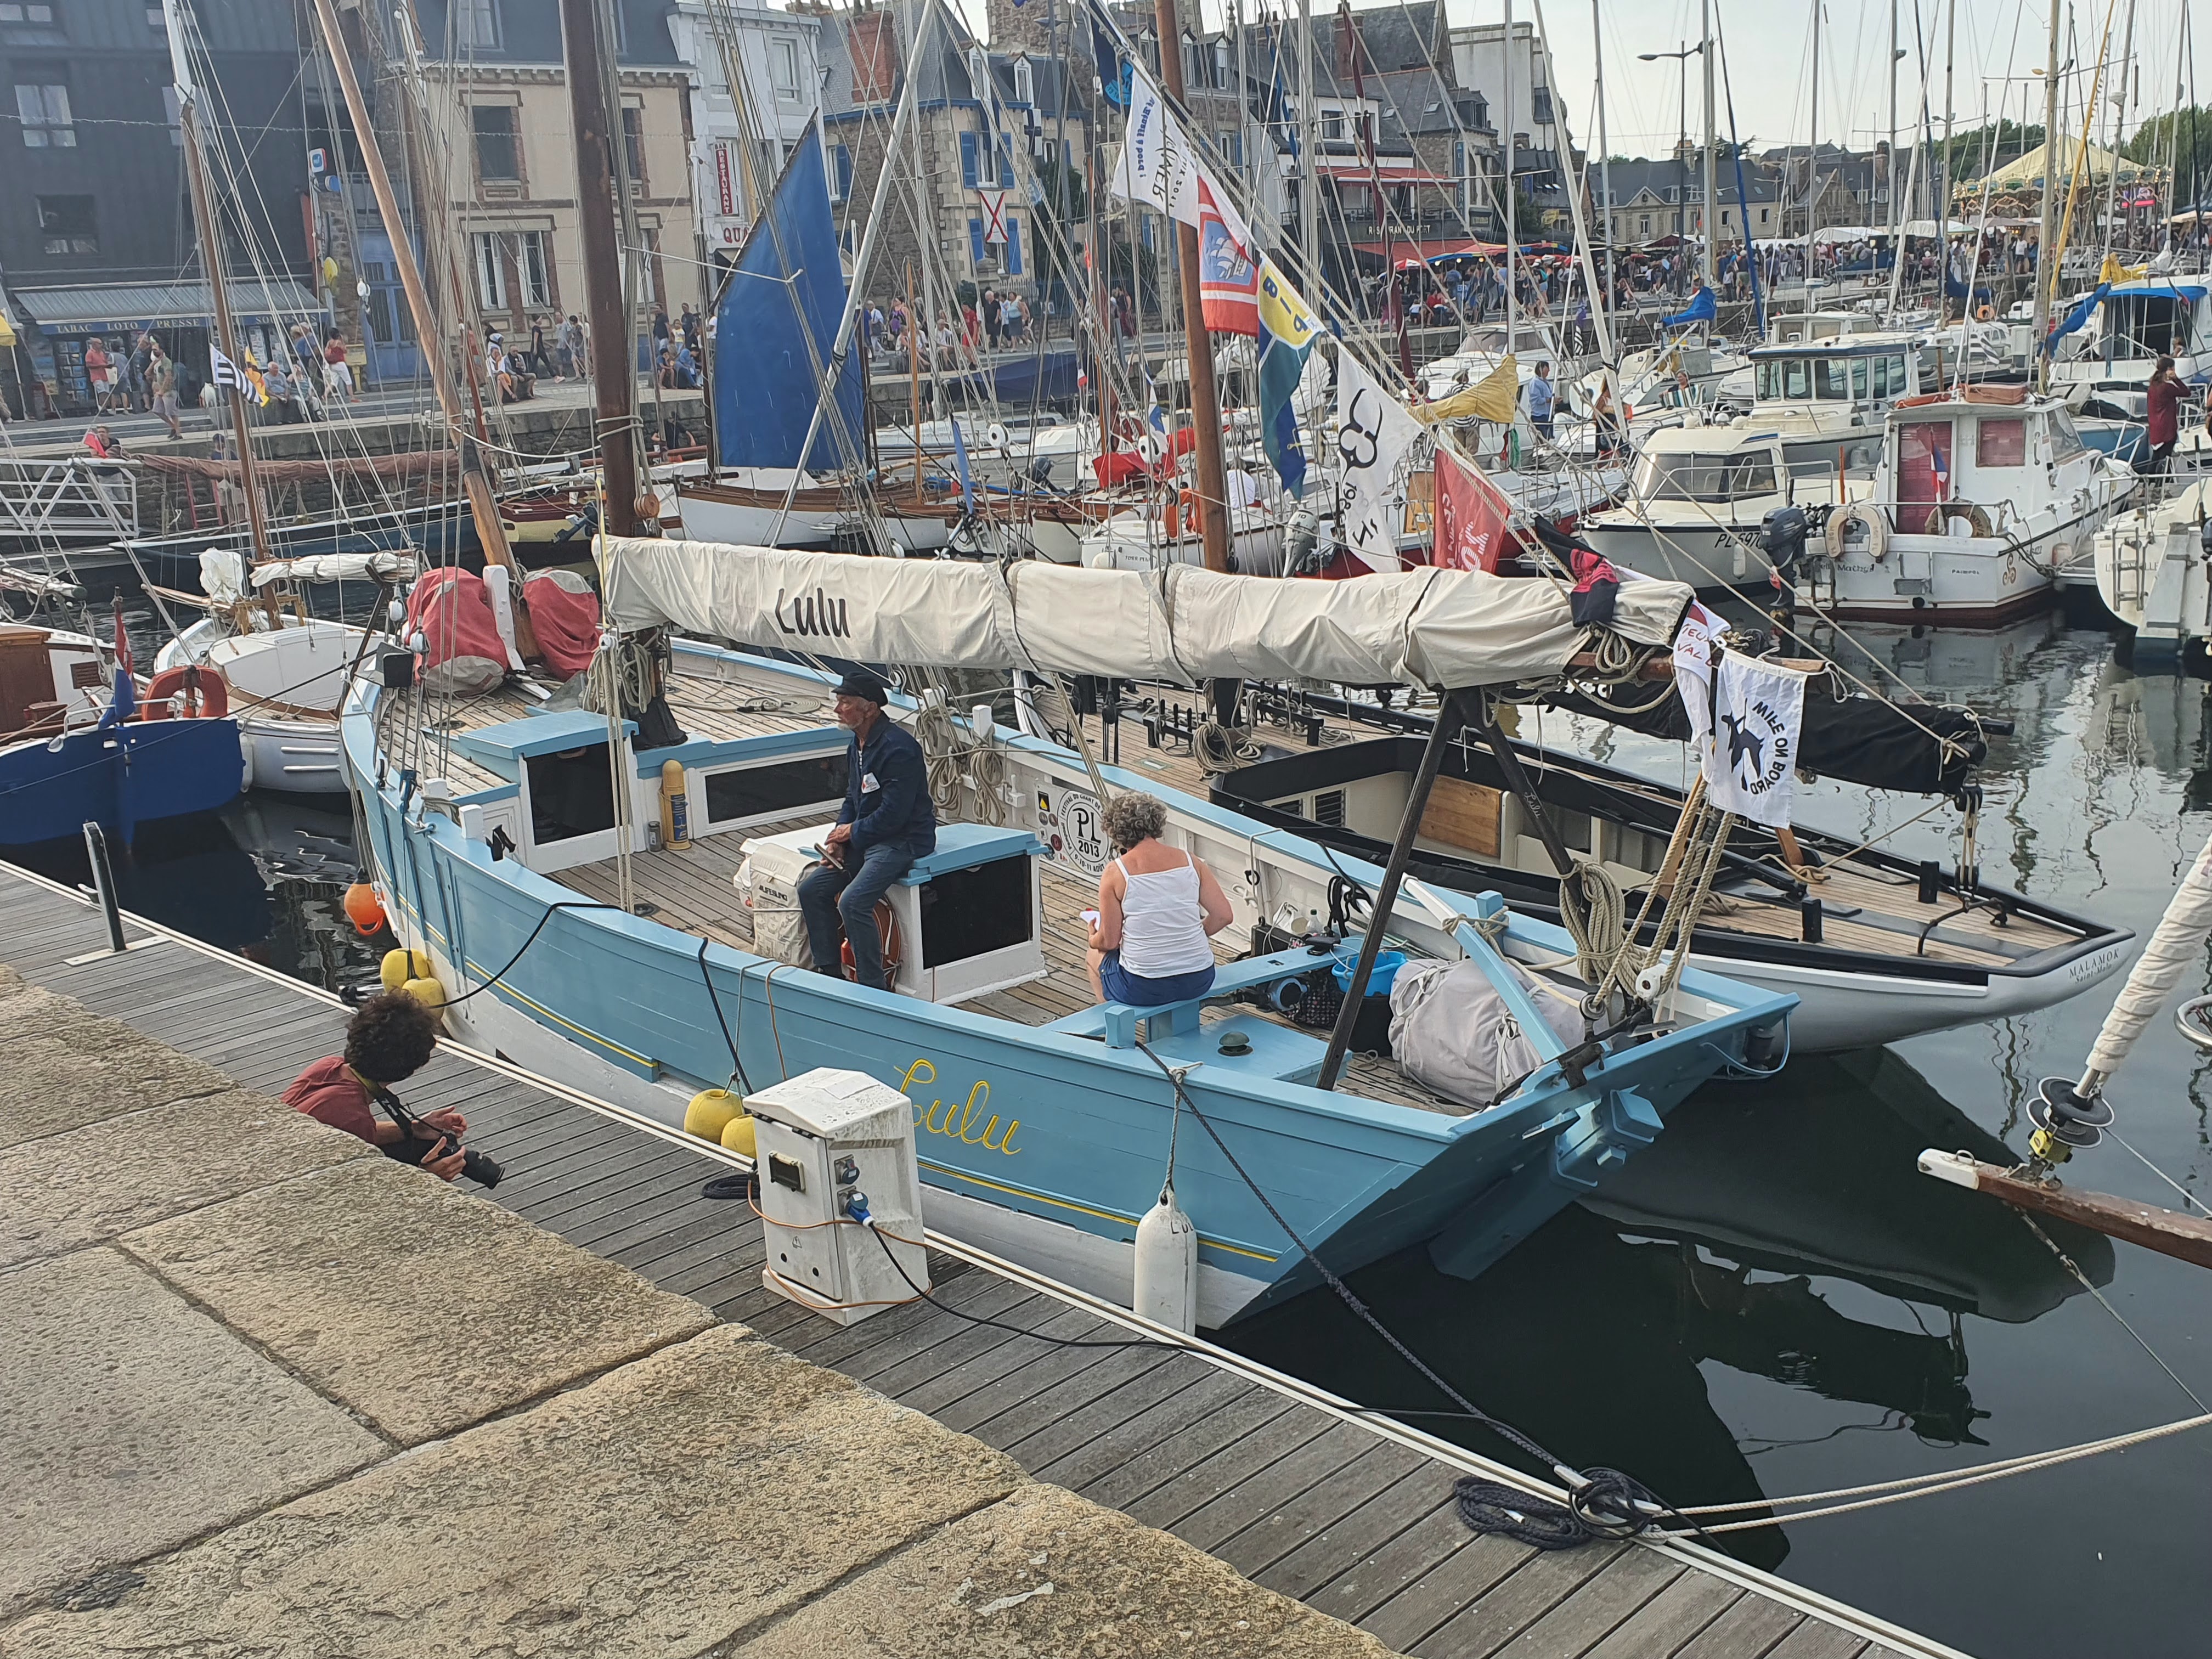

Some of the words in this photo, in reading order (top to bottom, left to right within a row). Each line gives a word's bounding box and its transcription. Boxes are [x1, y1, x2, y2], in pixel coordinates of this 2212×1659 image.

[718, 150, 730, 213] RESTAURANT
[1407, 225, 1414, 234] DU
[57, 324, 92, 333] TABAC
[106, 321, 138, 331] LOTO
[156, 318, 200, 328] PRESSE
[775, 587, 851, 638] Lulu
[1061, 794, 1074, 816] FESTIVAL
[1080, 794, 1094, 804] CHANT
[1073, 808, 1101, 844] PL
[1078, 840, 1100, 857] 2013
[2069, 948, 2119, 979] MALAMOK
